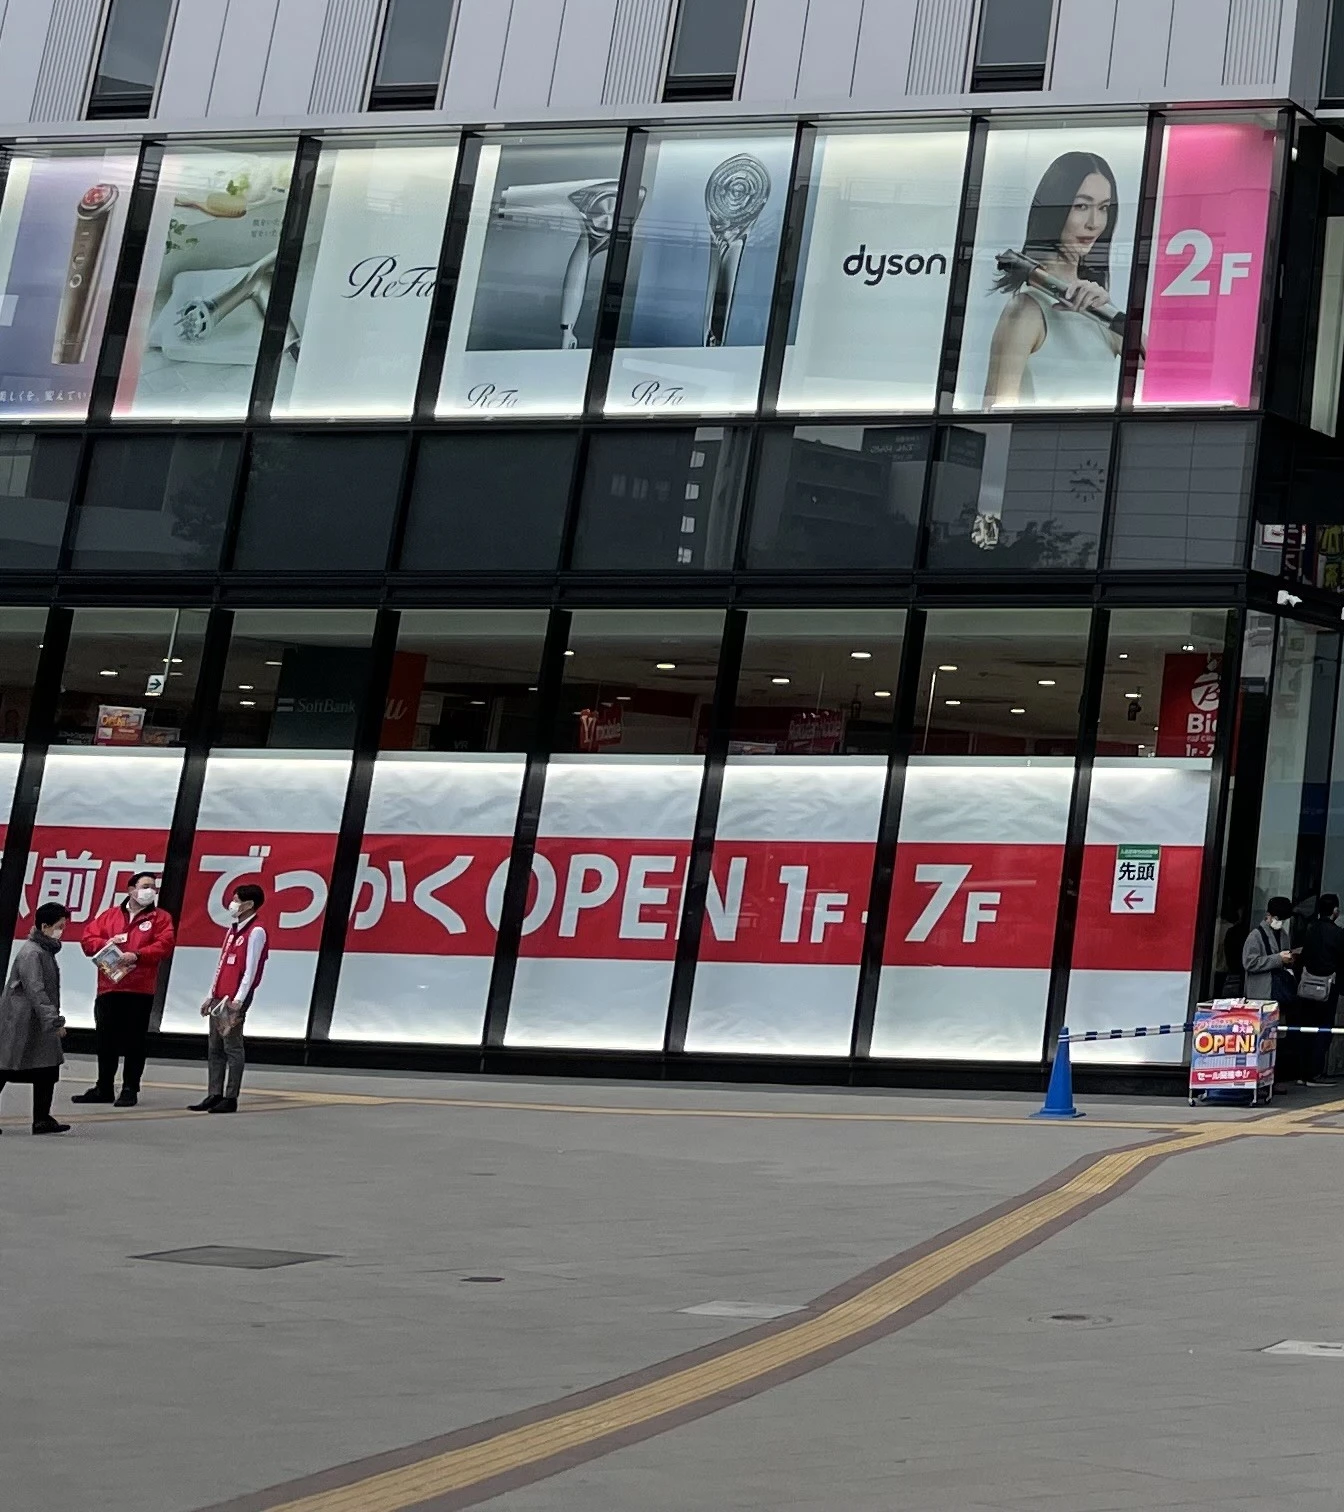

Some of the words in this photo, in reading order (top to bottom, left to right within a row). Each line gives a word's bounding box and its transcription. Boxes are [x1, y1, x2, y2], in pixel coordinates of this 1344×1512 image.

[843, 245, 946, 286] dyson
[1160, 229, 1252, 297] 2F
[298, 698, 356, 713] SoftBank
[1118, 862, 1154, 880] 先頭
[486, 853, 747, 942] OPEN
[1195, 1032, 1256, 1053] OPEN!
